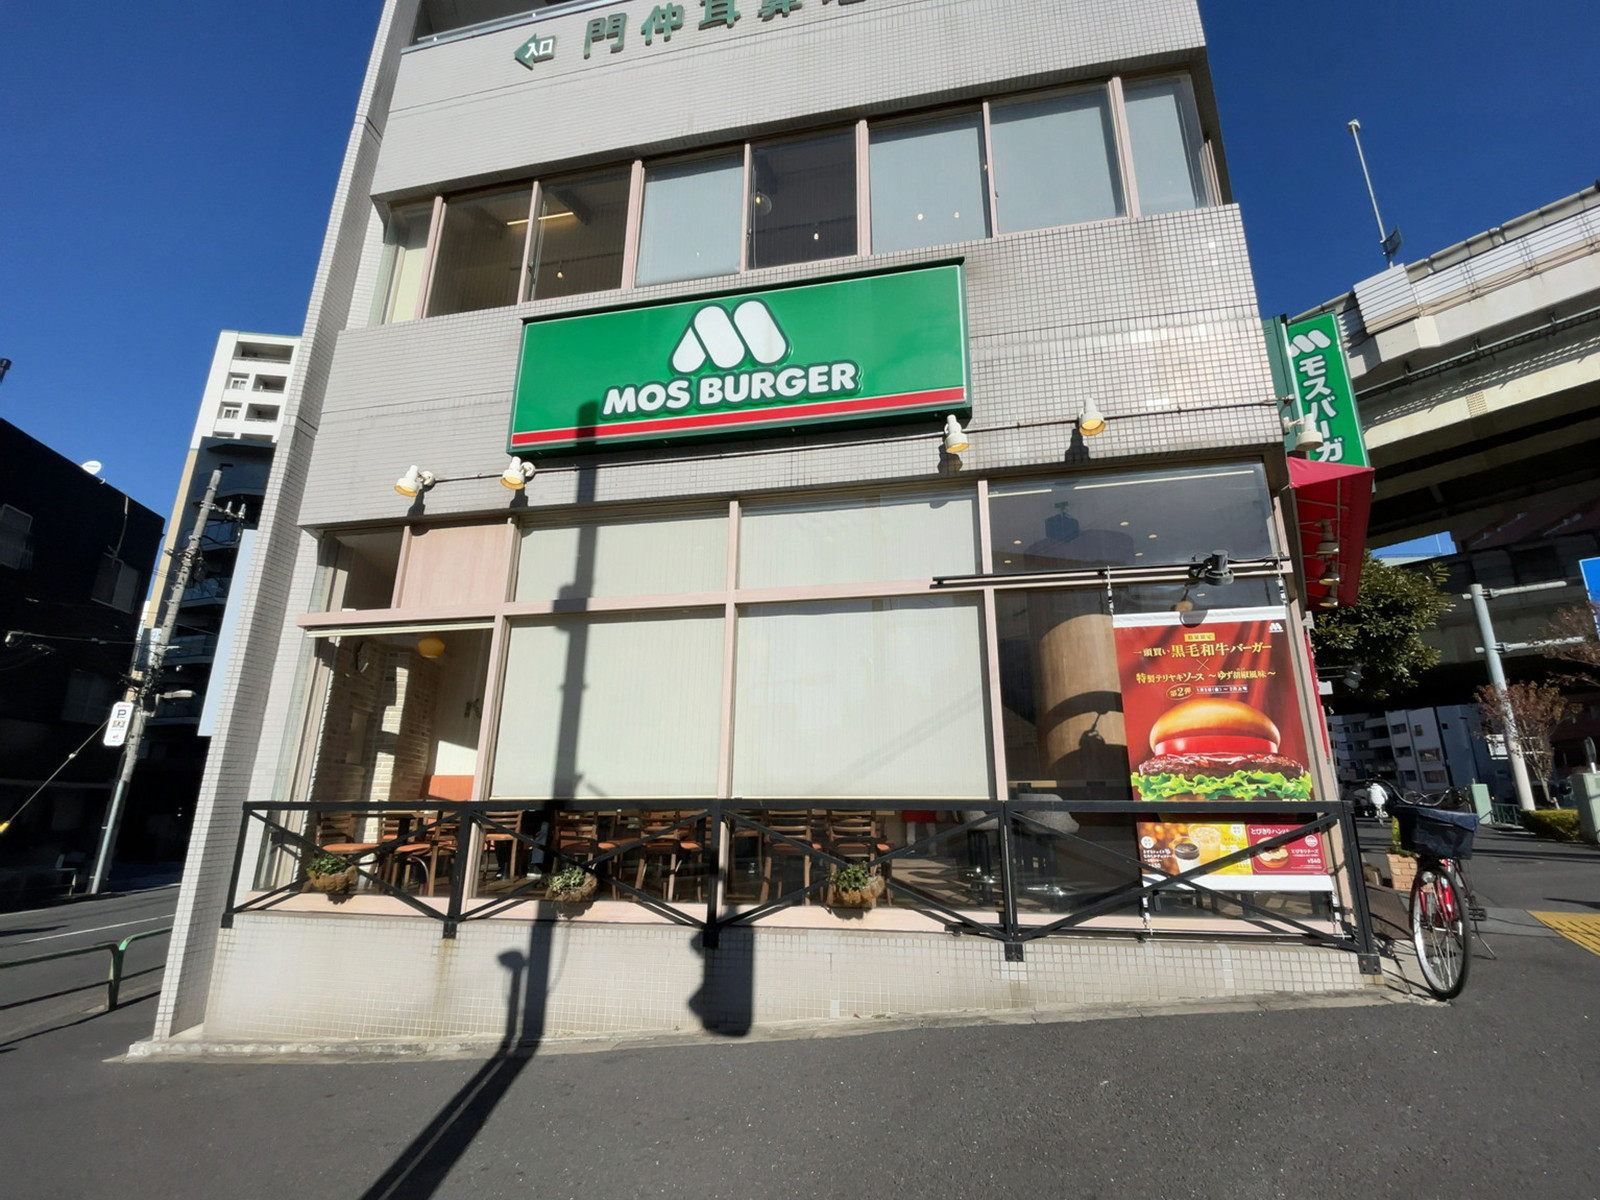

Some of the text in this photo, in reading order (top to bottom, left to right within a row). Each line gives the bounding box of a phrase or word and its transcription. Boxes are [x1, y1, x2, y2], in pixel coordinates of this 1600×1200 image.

[525, 39, 553, 58] 入口
[603, 362, 857, 415] MOS BURGER
